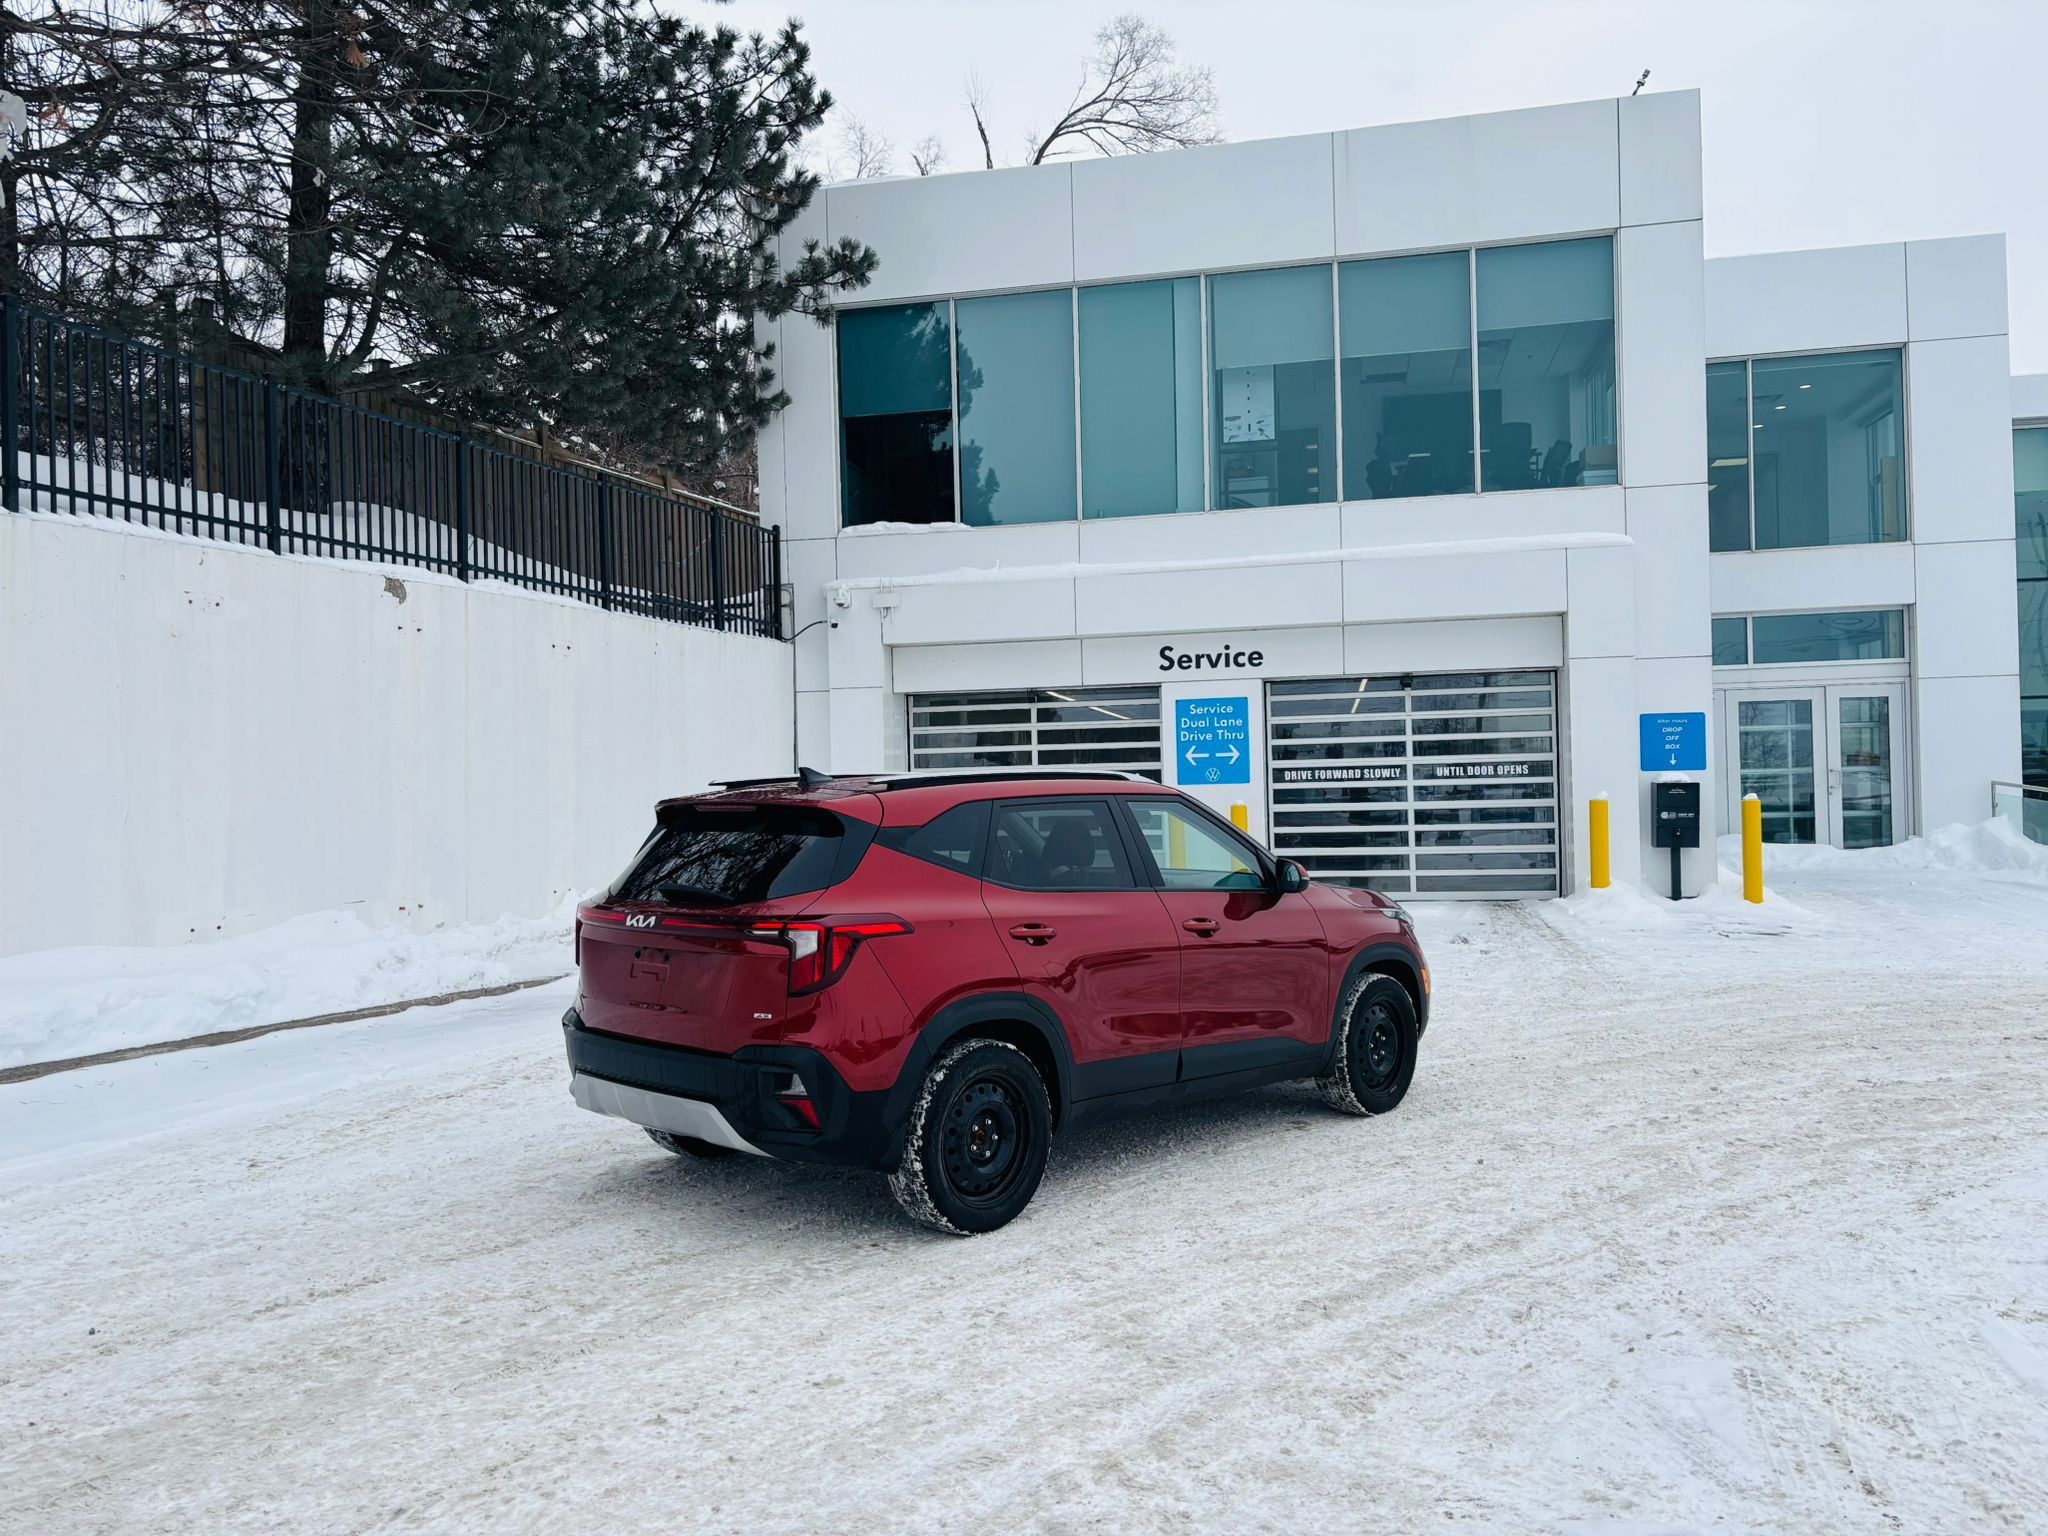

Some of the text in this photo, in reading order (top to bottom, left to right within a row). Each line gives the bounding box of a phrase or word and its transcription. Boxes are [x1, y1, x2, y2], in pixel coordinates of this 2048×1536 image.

[1159, 644, 1264, 671] Service
[1189, 703, 1234, 715] Service
[1181, 716, 1243, 728] Dual Lane
[1180, 729, 1245, 742] Drive Thru
[1284, 767, 1401, 781] DRIVE FORWARD SLOWLY
[1436, 764, 1529, 777] UNTIL DOOR OPENS
